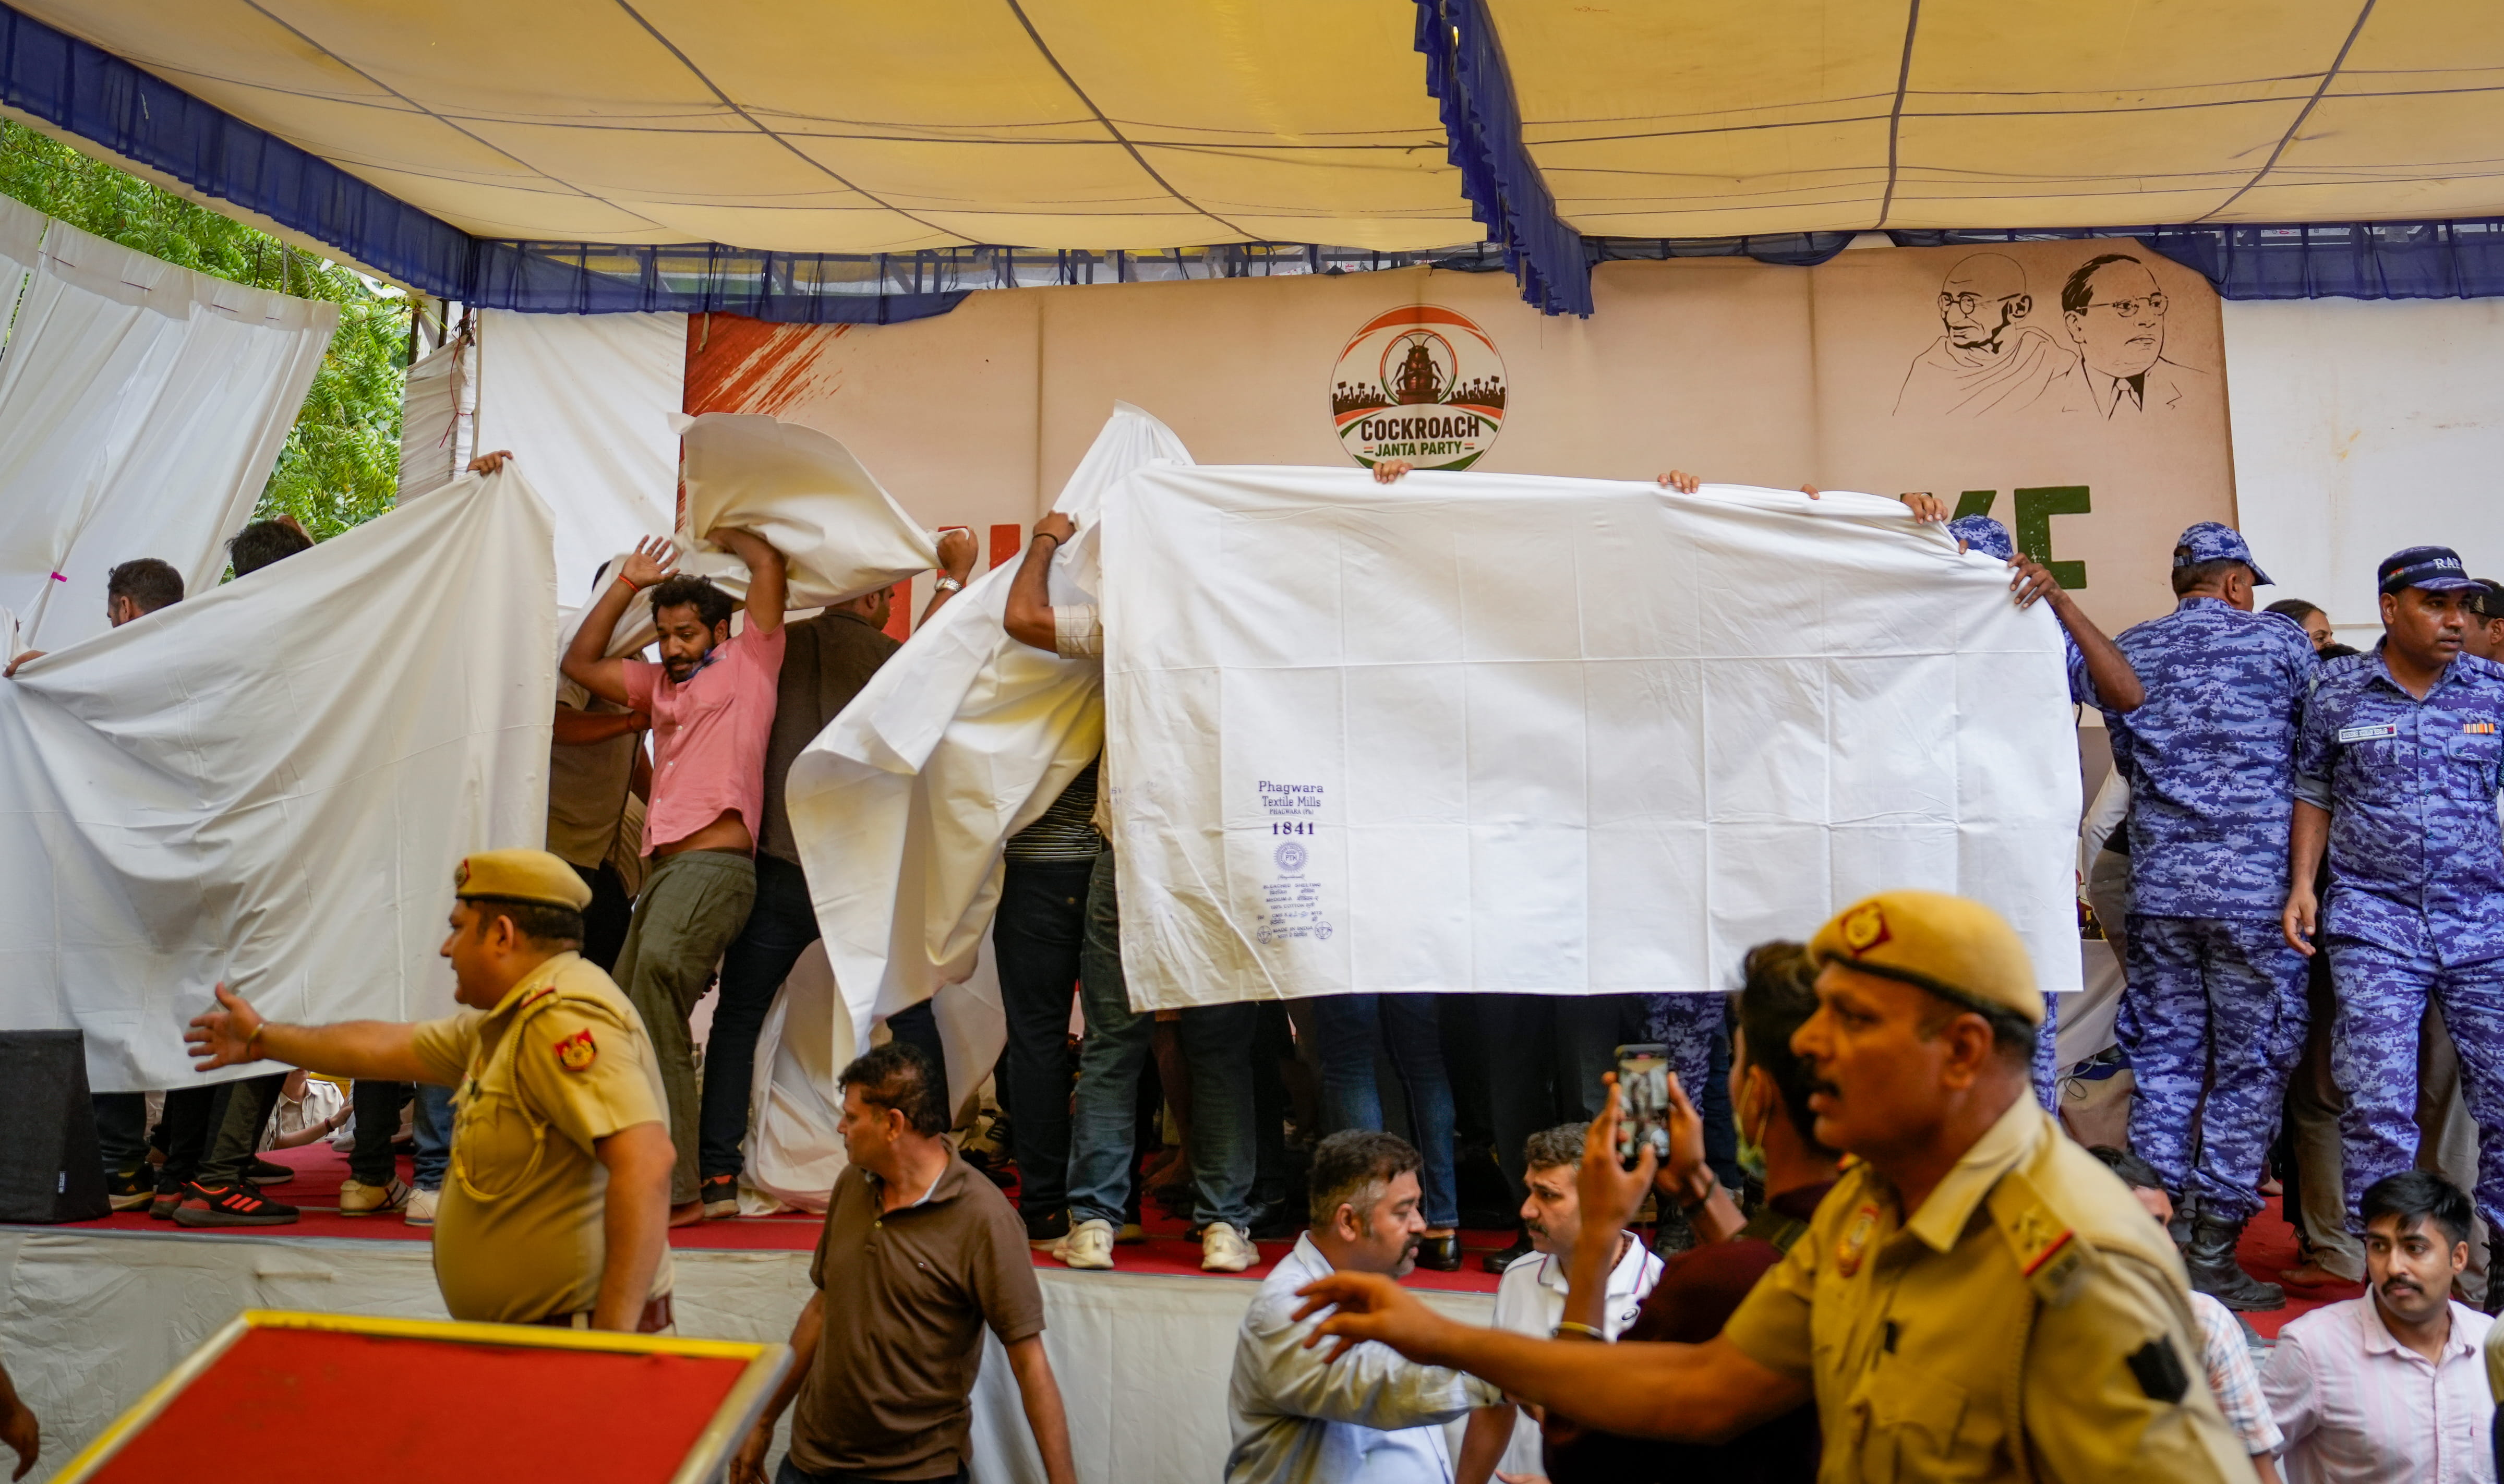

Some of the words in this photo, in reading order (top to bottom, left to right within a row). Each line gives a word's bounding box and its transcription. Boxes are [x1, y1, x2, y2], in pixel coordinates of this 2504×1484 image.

[1361, 416, 1479, 441] COCKROACH
[1375, 442, 1416, 456] JANTA
[1420, 441, 1462, 456] PARTY
[1258, 780, 1324, 794] Phagwara
[1262, 795, 1294, 806] Textile
[1297, 796, 1321, 807] Mills
[1272, 821, 1314, 835] 1841
